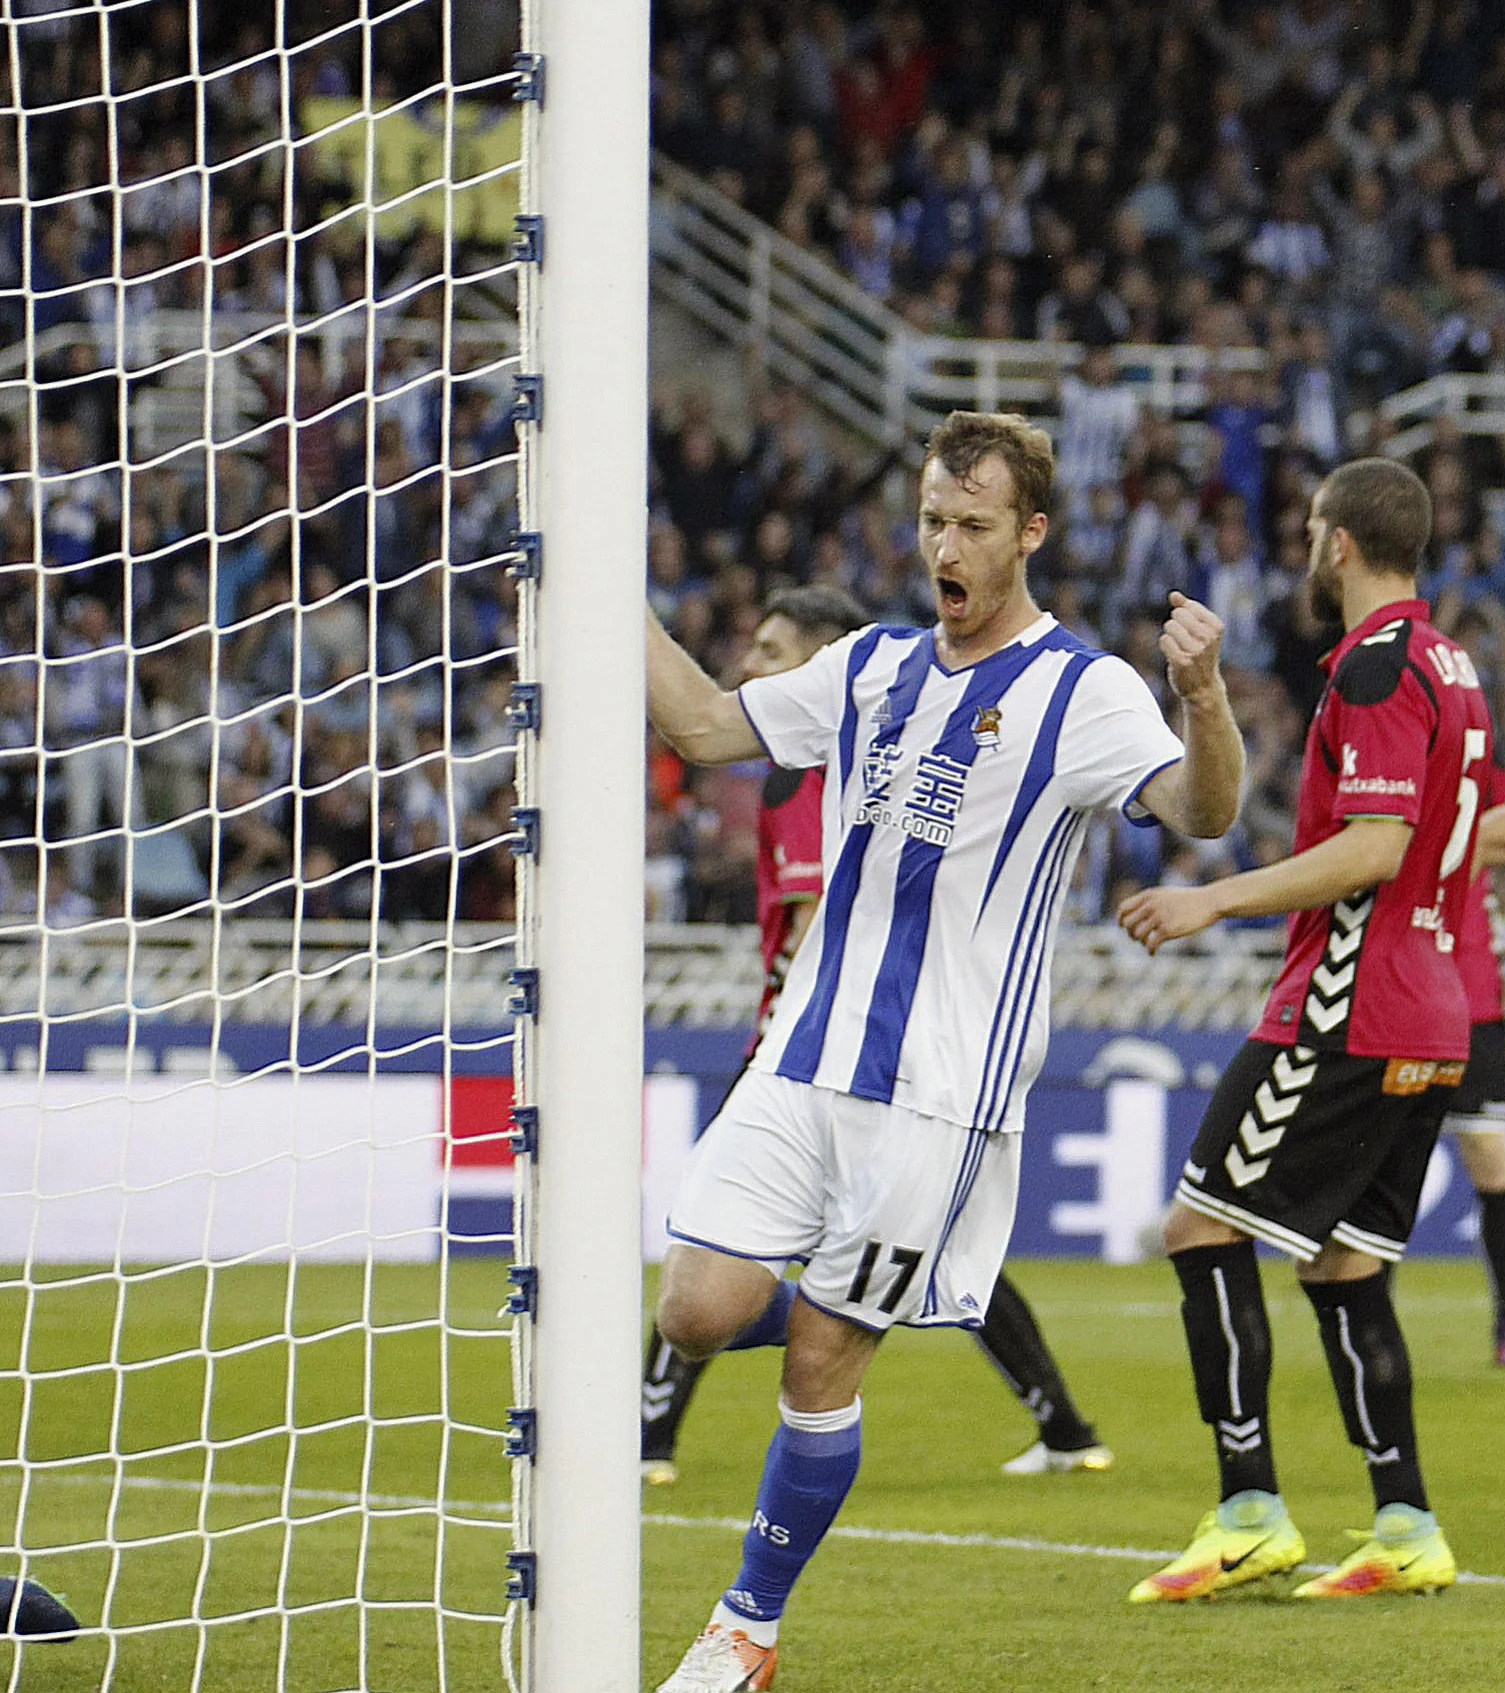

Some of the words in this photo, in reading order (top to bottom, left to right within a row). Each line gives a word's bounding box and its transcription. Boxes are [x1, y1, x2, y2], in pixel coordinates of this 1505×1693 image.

[1439, 728, 1487, 881] 5
[846, 1239, 924, 1314] 17
[752, 1509, 791, 1546] RS
